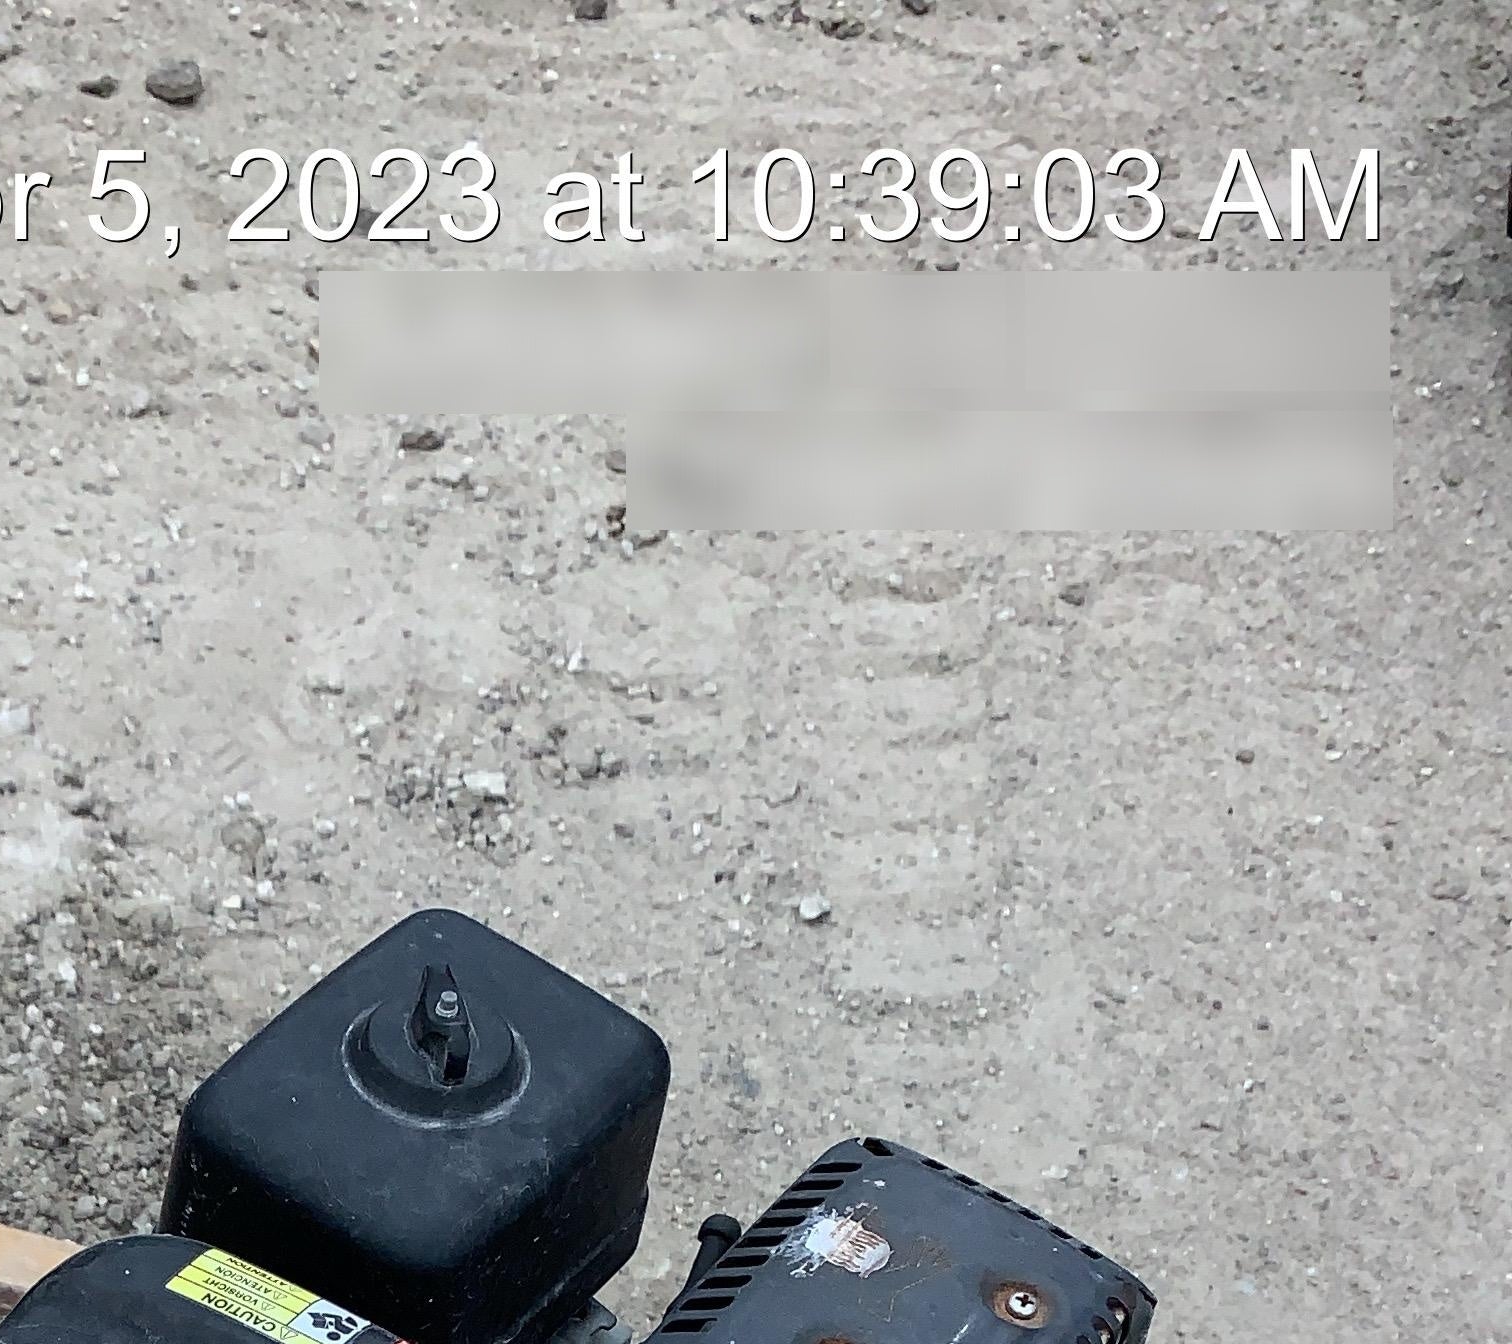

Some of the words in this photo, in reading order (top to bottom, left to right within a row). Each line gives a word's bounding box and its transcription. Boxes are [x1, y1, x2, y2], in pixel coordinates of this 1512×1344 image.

[225, 1257, 288, 1286] ATTENTION
[201, 1276, 259, 1306] VORSICHT
[200, 1292, 277, 1332] CAUTION
